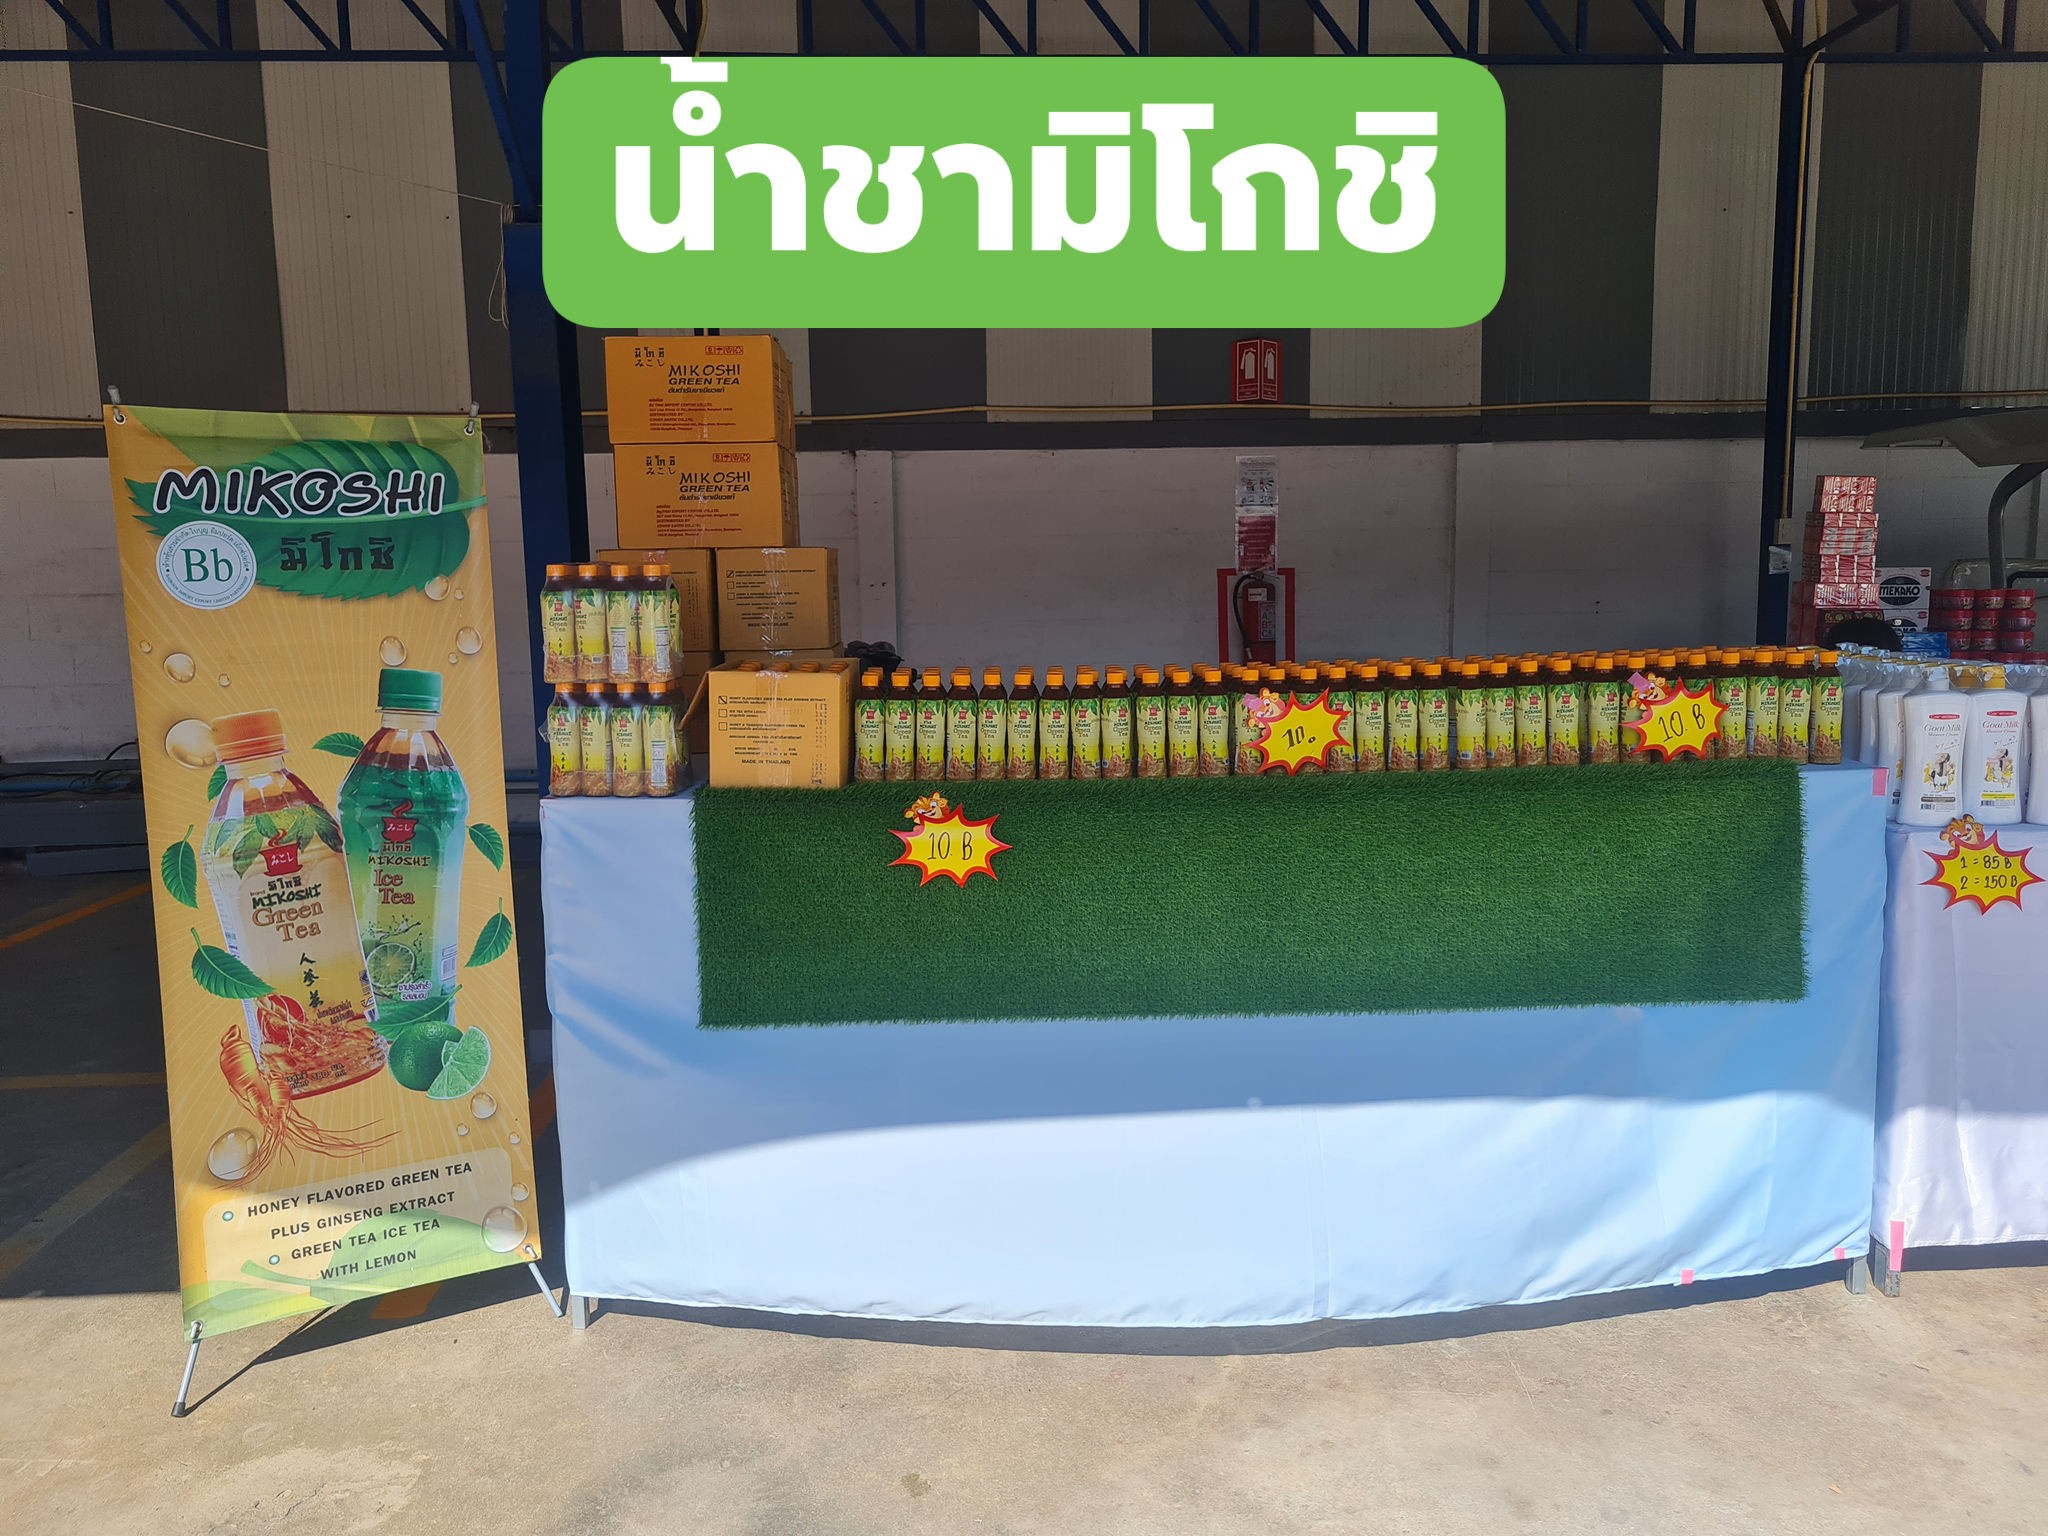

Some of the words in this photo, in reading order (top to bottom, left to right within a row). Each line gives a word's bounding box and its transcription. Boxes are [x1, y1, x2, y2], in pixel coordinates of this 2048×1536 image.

[668, 364, 741, 377] MIKOSHI
[668, 378, 713, 386] GREEN
[716, 377, 740, 385] TEA
[679, 471, 751, 485] MIKOSHI
[153, 466, 445, 518] MIKOSHI
[679, 485, 723, 493] GREEN
[727, 484, 750, 492] TEA
[280, 531, 396, 573] มิโกชิ
[180, 547, 233, 582] Bb
[1692, 704, 1705, 729] B
[387, 823, 411, 831] みこし
[962, 831, 973, 860] B
[271, 852, 294, 866] みこし
[368, 855, 431, 866] MIKOSHI
[1960, 856, 1967, 868] 1
[1983, 855, 2000, 869] 85
[2004, 857, 2012, 869] B
[373, 869, 404, 887] Ice
[1960, 875, 1968, 889] 2
[1984, 875, 2007, 889] 150
[2010, 875, 2018, 887] B
[252, 883, 322, 909] MIKOSHI
[379, 888, 415, 905] Tea
[252, 901, 324, 927] Green
[276, 922, 321, 942] Tea
[248, 1196, 300, 1217] HONEY
[307, 1180, 385, 1205] FLAVORED
[391, 1168, 440, 1188] GREEN
[446, 1162, 472, 1177] TEA
[271, 1222, 311, 1240] PLUS
[317, 1206, 383, 1229] GINSENG
[390, 1191, 456, 1214] EXTRACT
[291, 1239, 342, 1260] GREEN
[348, 1232, 377, 1247] TEA
[383, 1225, 408, 1239] ICE
[412, 1218, 441, 1233] TEA
[320, 1263, 359, 1280] WITH
[365, 1250, 417, 1271] LEMON
